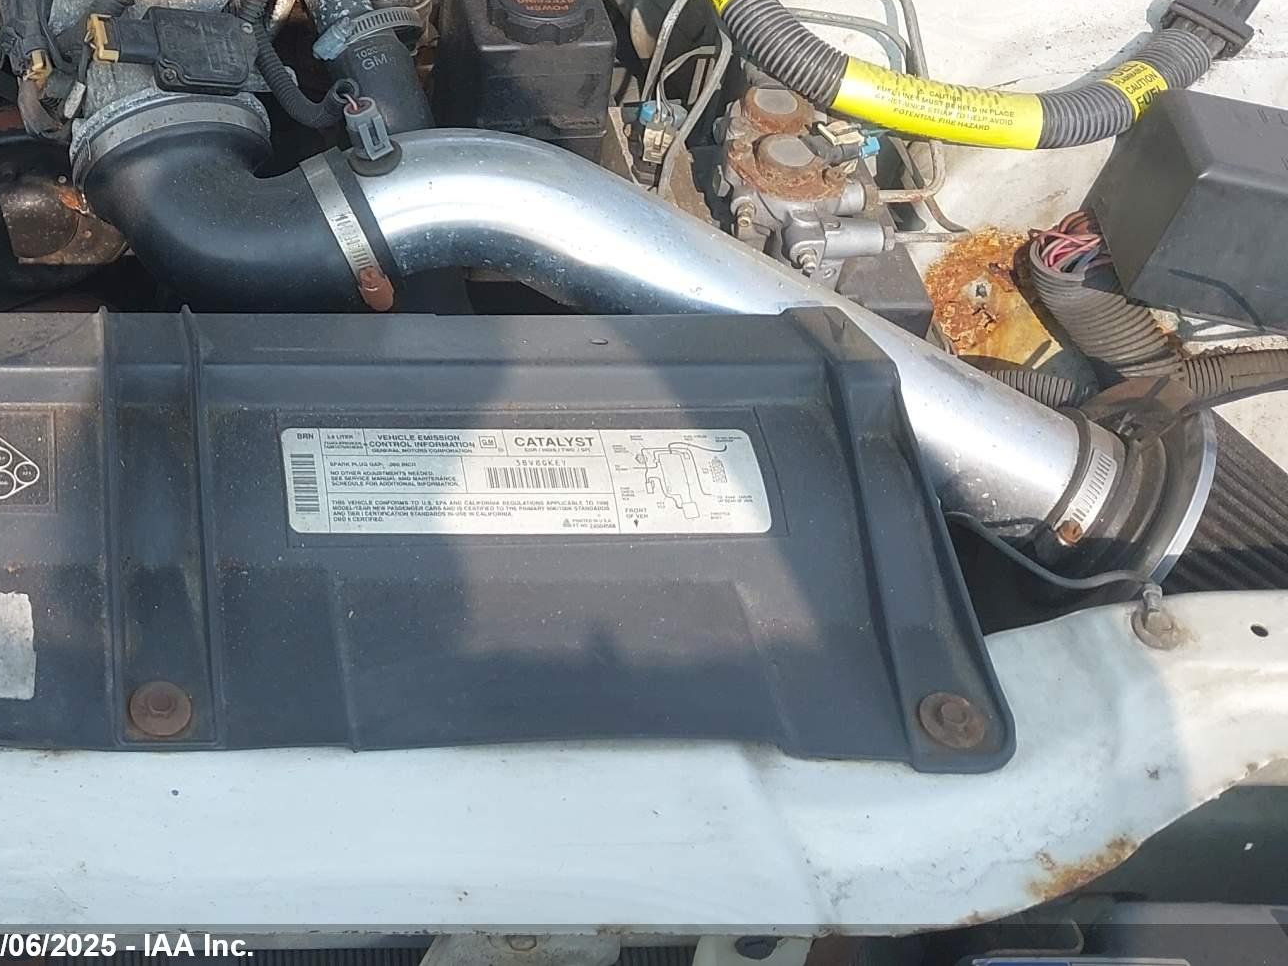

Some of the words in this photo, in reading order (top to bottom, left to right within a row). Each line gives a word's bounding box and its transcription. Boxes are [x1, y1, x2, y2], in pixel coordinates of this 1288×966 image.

[362, 54, 389, 72] GM
[1125, 73, 1157, 94] CAUTION
[893, 108, 936, 122] POTENTIAL
[989, 108, 1015, 118] PLACE
[990, 117, 1013, 126] AVOID
[514, 437, 594, 447] CATALYST
